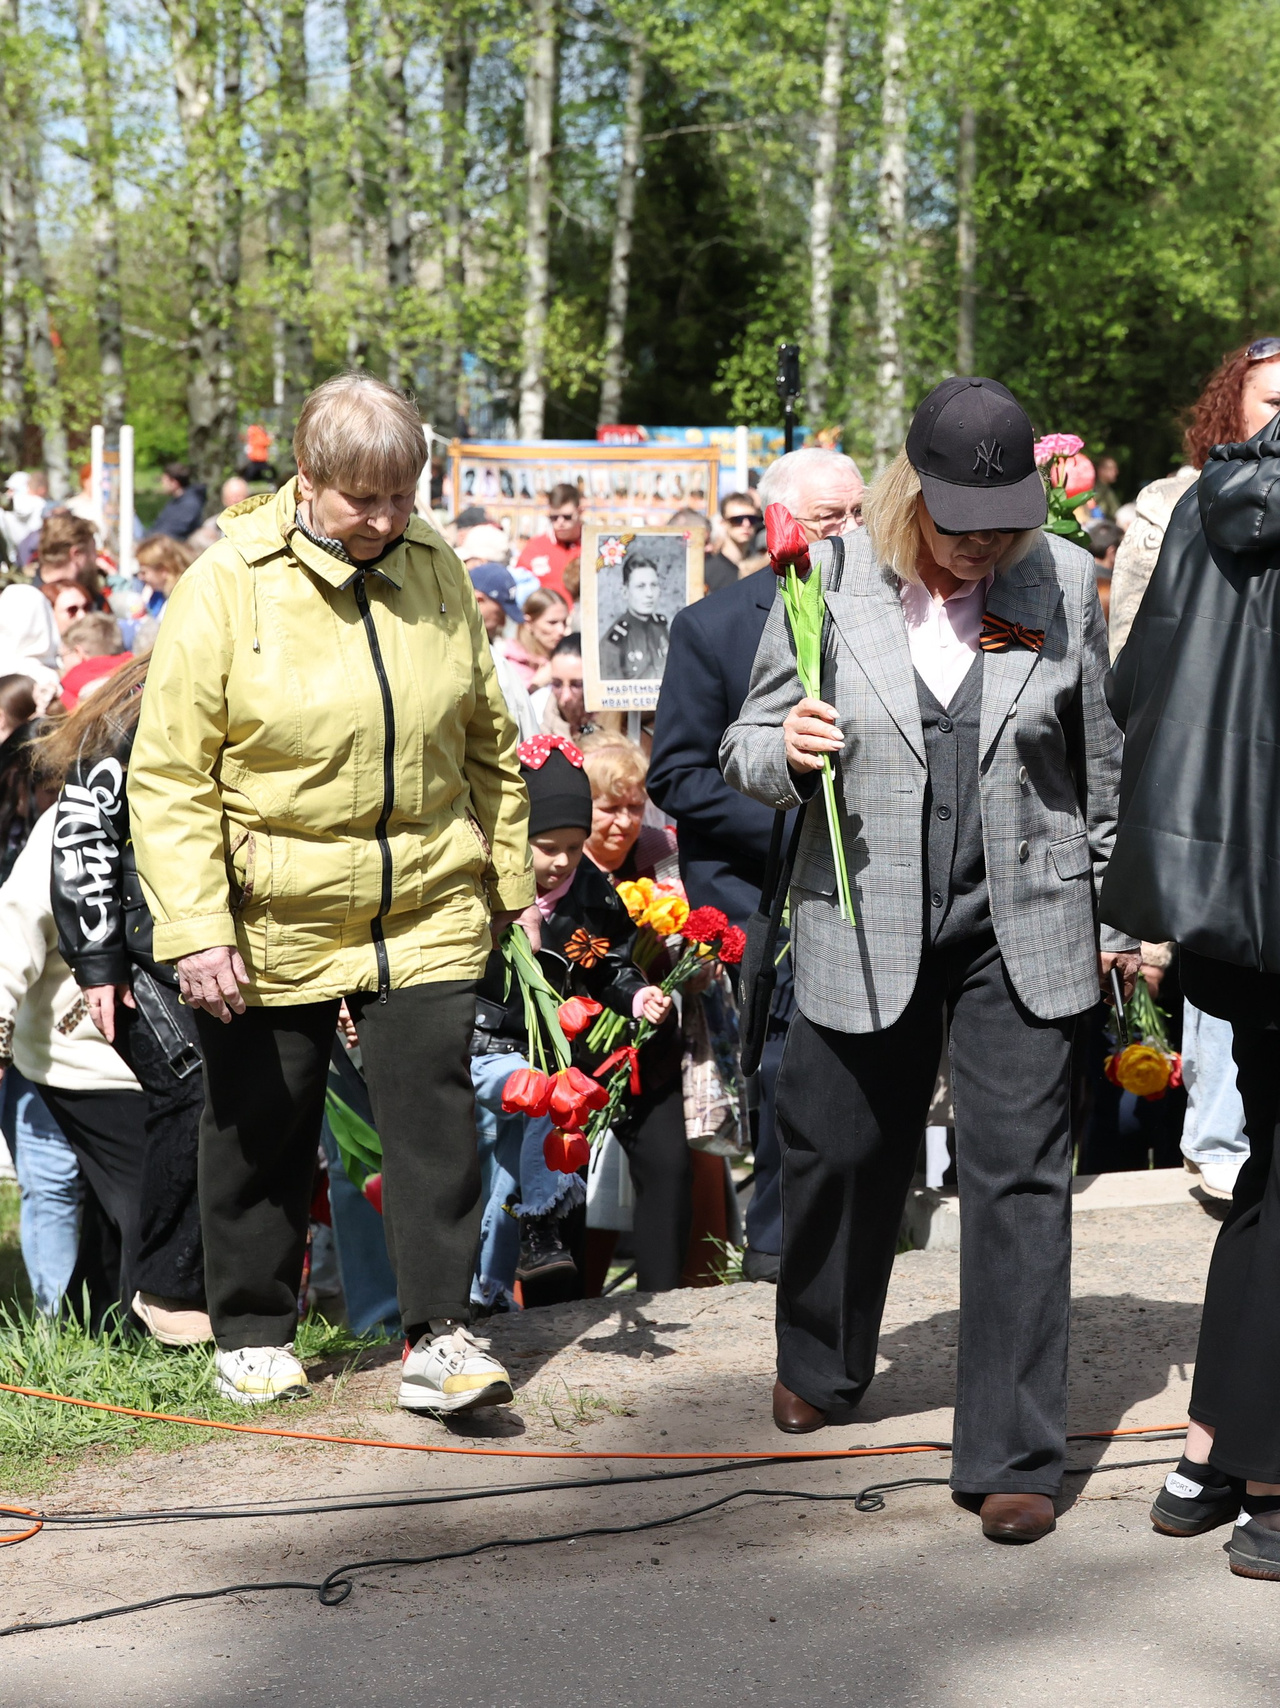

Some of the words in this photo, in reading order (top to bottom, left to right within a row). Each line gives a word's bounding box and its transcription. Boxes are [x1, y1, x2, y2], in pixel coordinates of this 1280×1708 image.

[973, 438, 1004, 477] NY
[607, 685, 660, 694] МАРТЕМЬЯ
[602, 698, 629, 707] ИВАН
[632, 698, 657, 707] СЕРГ
[1170, 1478, 1188, 1492] SPORT
